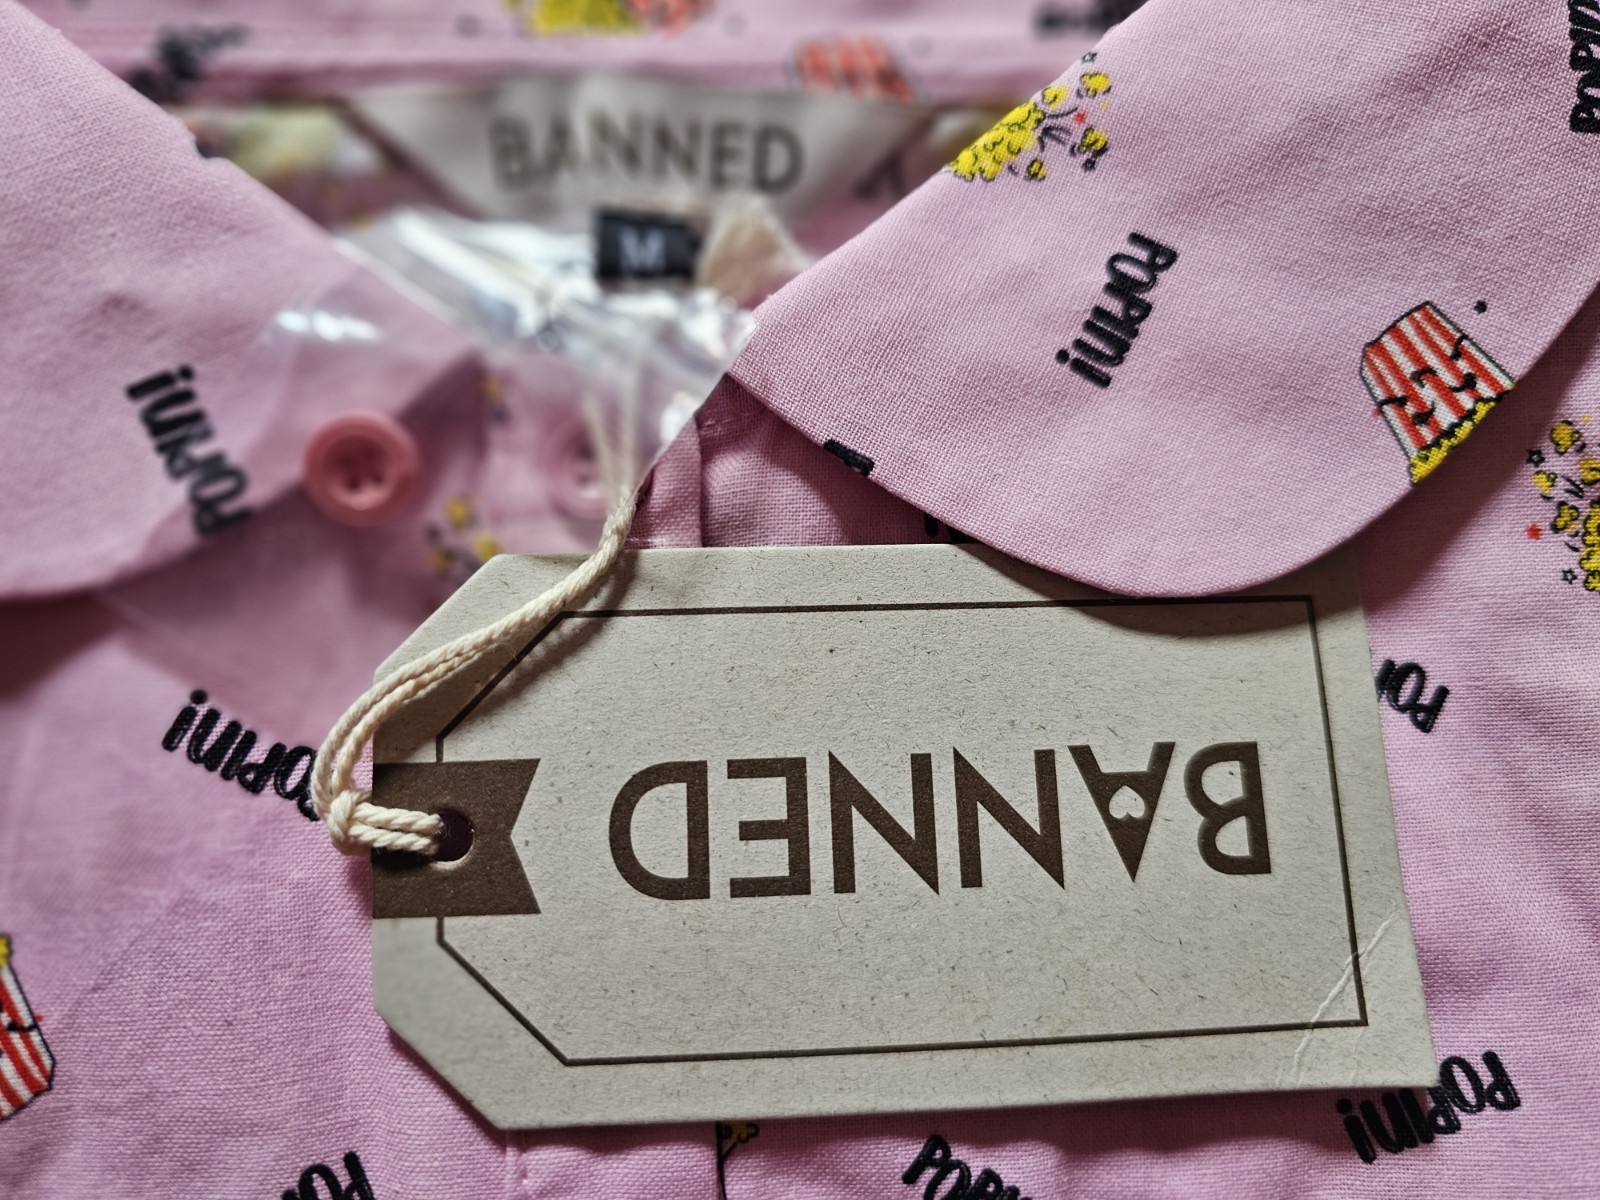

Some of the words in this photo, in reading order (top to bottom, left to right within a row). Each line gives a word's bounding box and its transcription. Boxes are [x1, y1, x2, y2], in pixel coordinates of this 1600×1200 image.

[489, 108, 805, 195] BANNED
[618, 225, 668, 273] M
[608, 740, 1272, 901] BANNED
